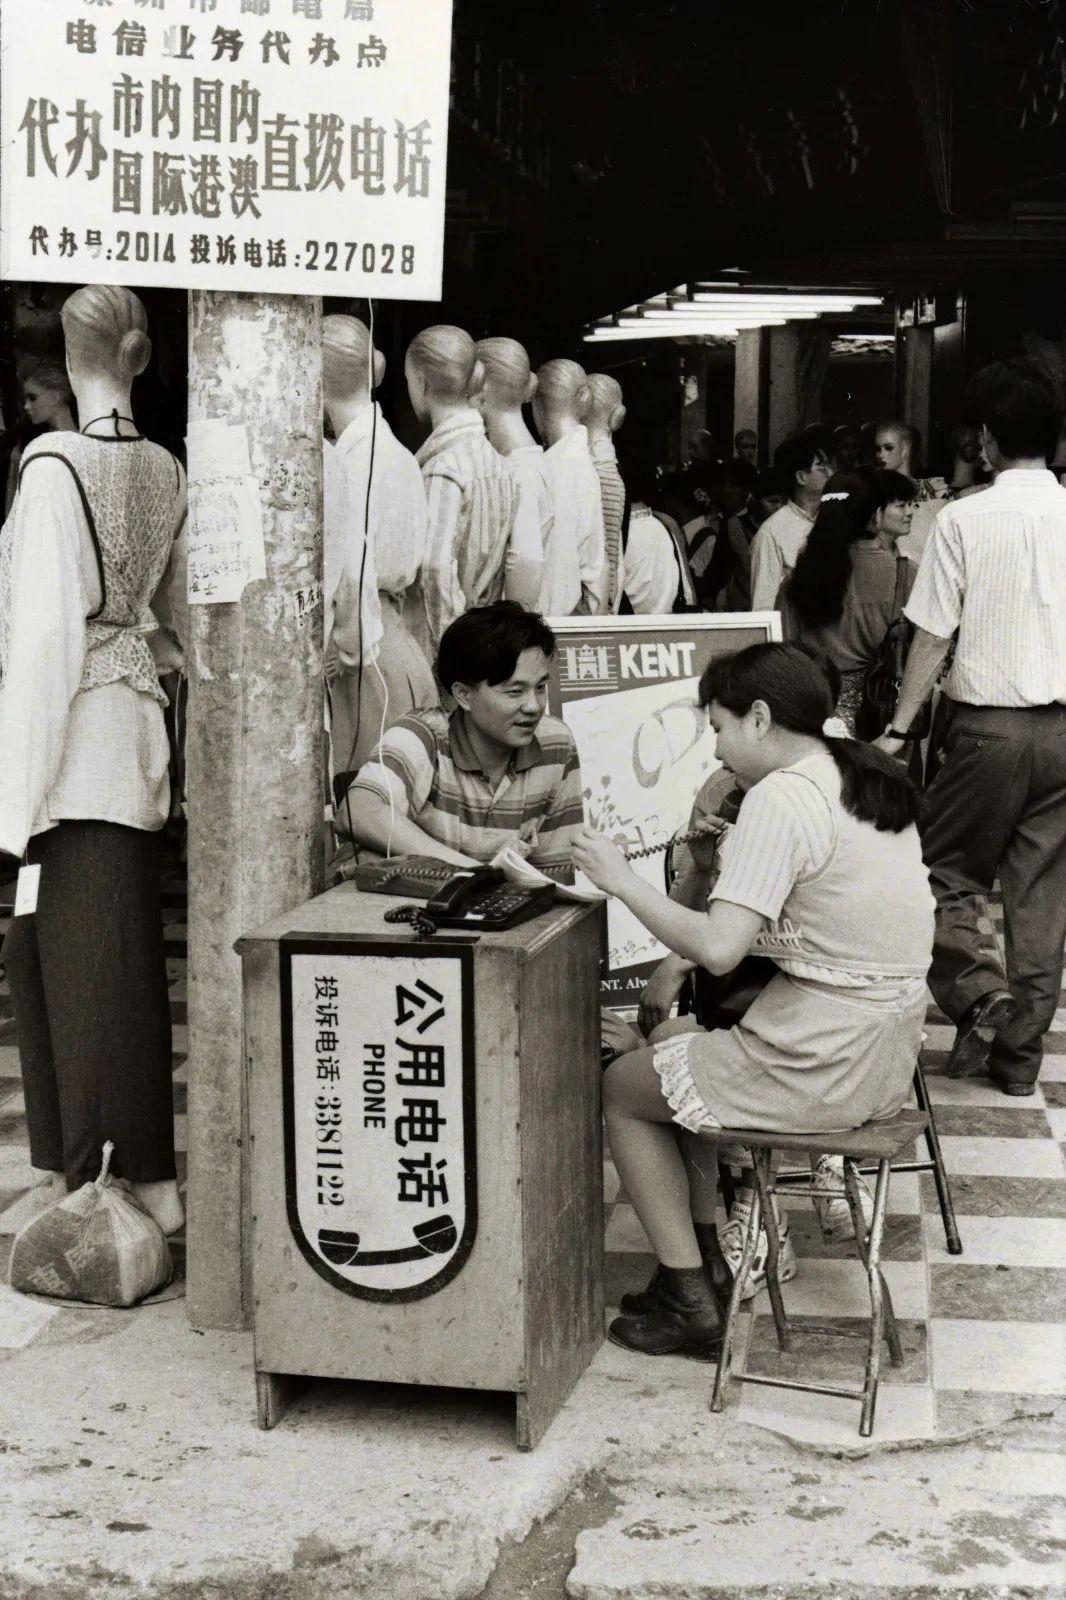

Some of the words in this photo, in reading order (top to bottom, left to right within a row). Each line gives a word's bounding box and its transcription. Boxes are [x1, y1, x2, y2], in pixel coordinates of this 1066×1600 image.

[66, 18, 388, 68] 电信业务代办点
[18, 96, 108, 181] 代办
[112, 72, 261, 145] 市内国内
[112, 149, 262, 219] 国际港澳
[262, 113, 432, 198] 直拨电话
[619, 642, 696, 679] KENT
[599, 978, 623, 991] NT.
[626, 976, 648, 989] Alw
[363, 1044, 386, 1129] PHONE
[395, 978, 449, 1208] 公用电话
